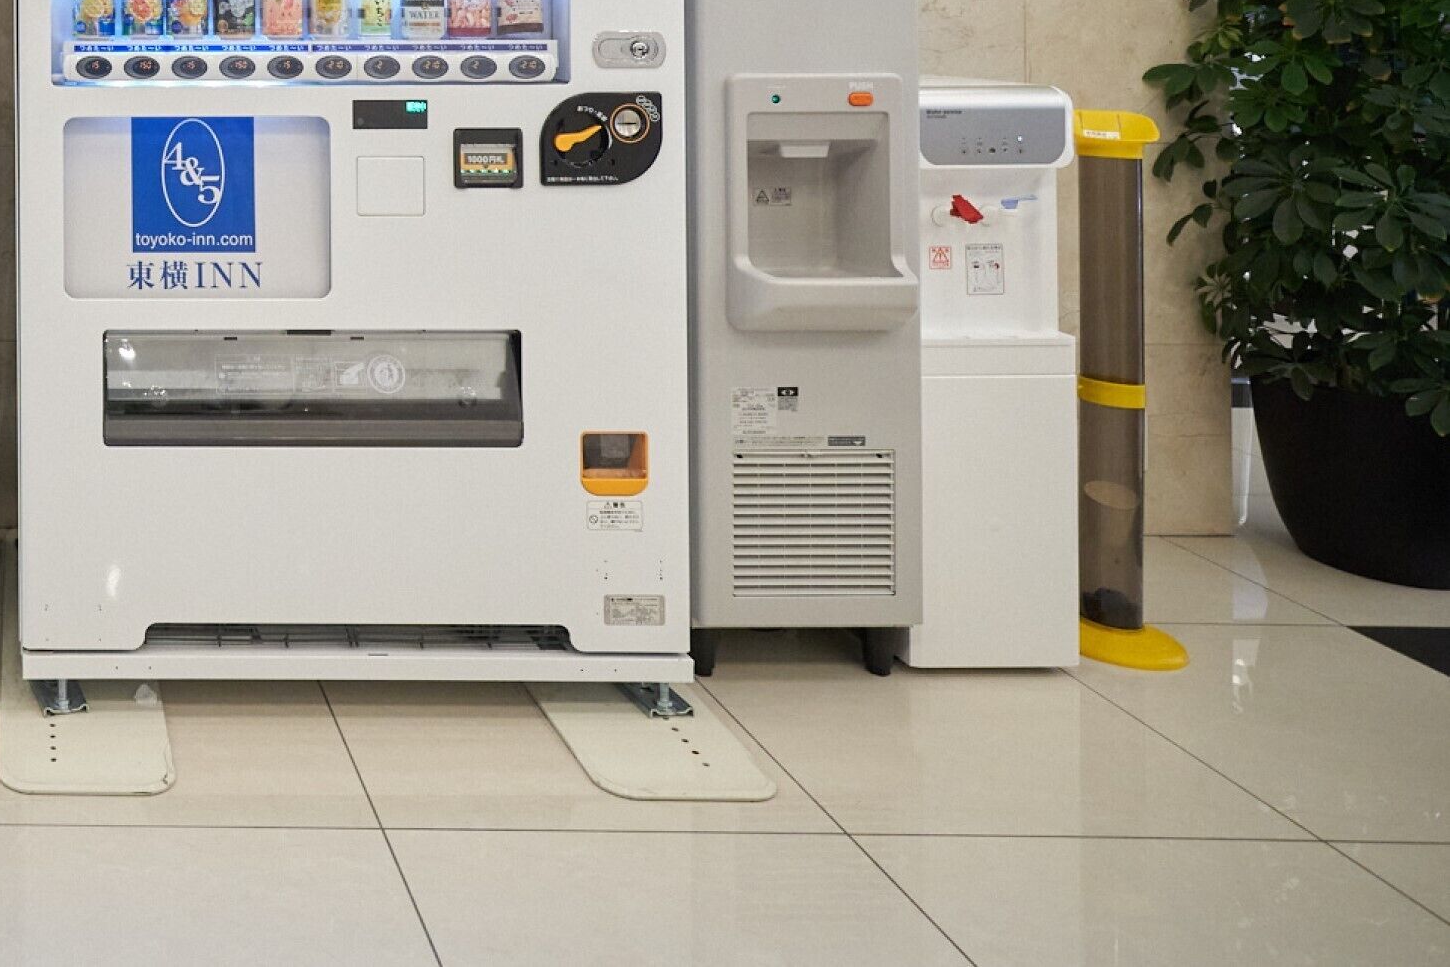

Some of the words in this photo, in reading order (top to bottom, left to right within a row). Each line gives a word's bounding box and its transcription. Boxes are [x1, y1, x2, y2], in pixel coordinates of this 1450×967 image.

[164, 141, 220, 205] 4&5
[135, 232, 253, 249] toyoko-inn.com
[126, 260, 263, 290] 東横INN
